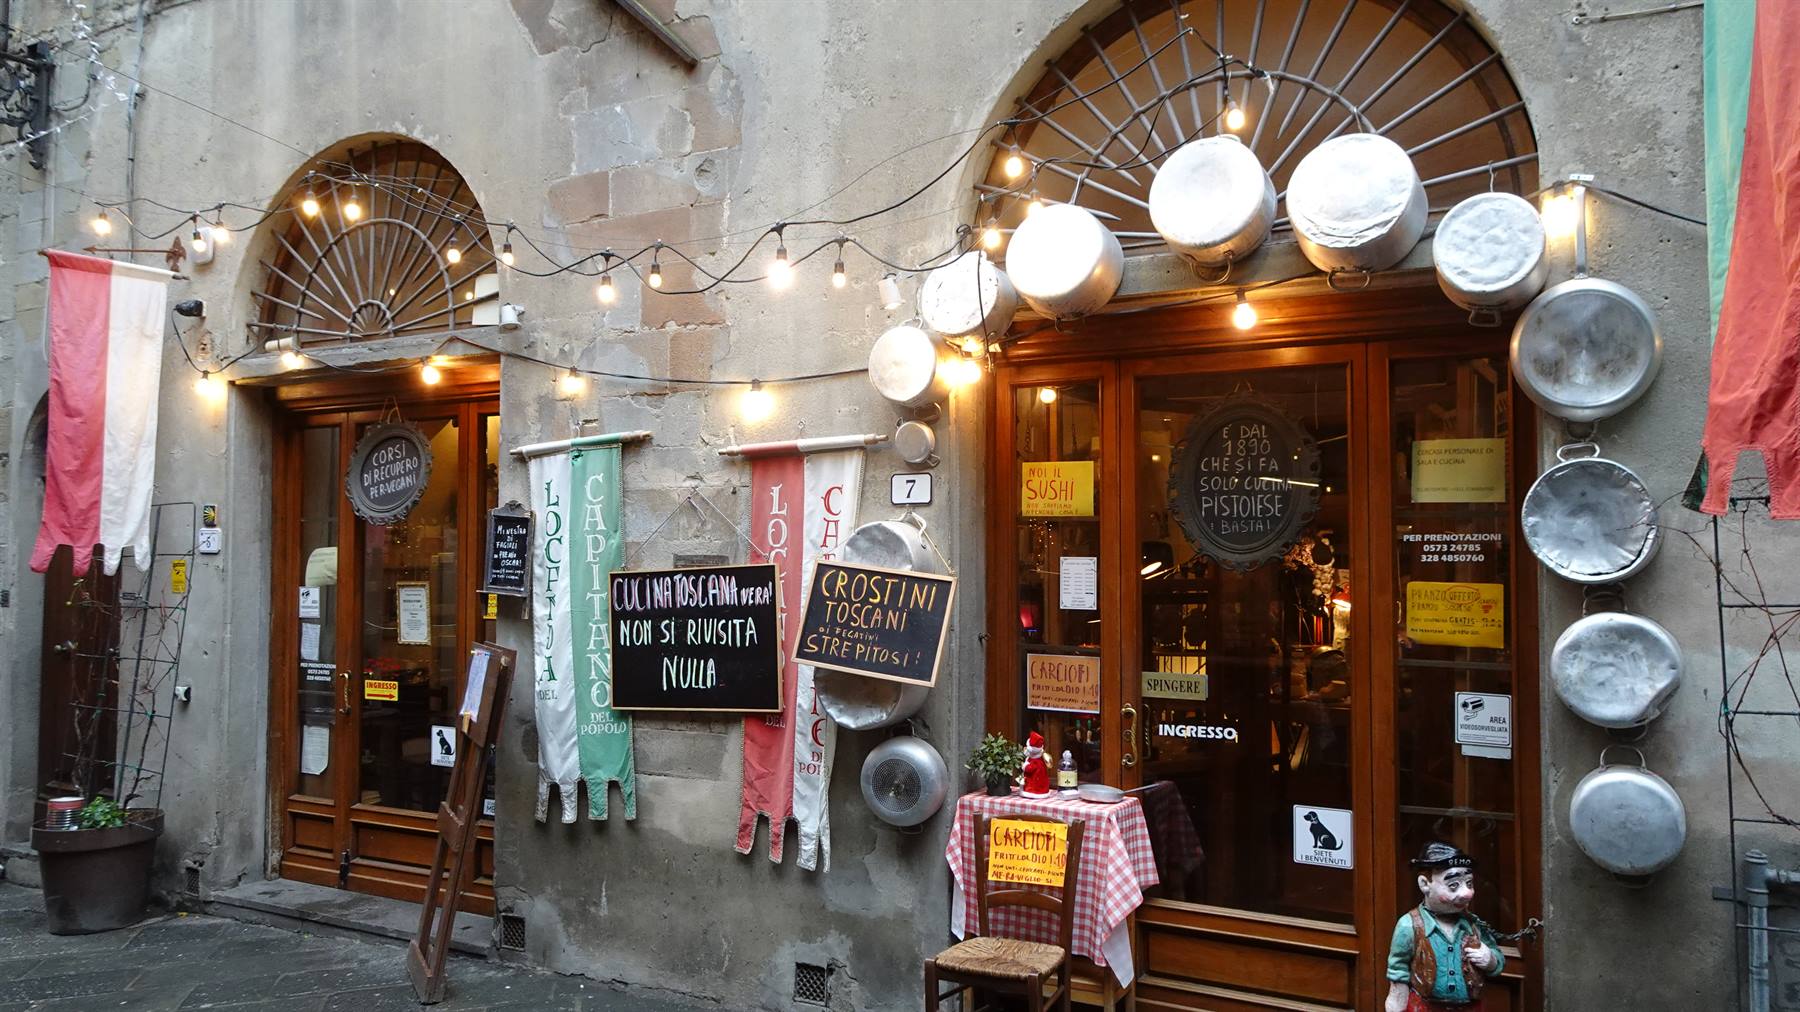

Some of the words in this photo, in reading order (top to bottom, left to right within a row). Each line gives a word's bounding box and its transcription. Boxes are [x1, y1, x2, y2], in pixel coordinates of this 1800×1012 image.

[1240, 425, 1268, 438] DAL
[372, 439, 406, 466] CORSI
[1222, 439, 1271, 456] 1890
[363, 470, 372, 486] DI
[374, 457, 418, 484] RECUPERO
[1029, 467, 1047, 478] NOI
[1201, 457, 1229, 472] CHE
[1234, 457, 1251, 472] SI
[1259, 457, 1279, 472] FA
[905, 479, 917, 499] 7
[1026, 478, 1075, 501] SUSHI
[1200, 476, 1238, 492] SOLO
[1244, 476, 1293, 492] CUCINA
[1201, 493, 1283, 517] PISTOIESE
[1221, 520, 1271, 534] BASTA!
[1423, 533, 1502, 541] PRENOTAZIONI
[1423, 544, 1448, 552] 0573
[1449, 544, 1481, 552] 24785
[1420, 554, 1439, 562] 328
[1441, 554, 1485, 562] 4850760
[612, 574, 673, 612] CUCINA
[673, 573, 738, 609] TOSCANA
[740, 580, 773, 606] VERA!
[821, 569, 937, 612] CROSTINI
[825, 600, 909, 632] TOSCANI
[620, 619, 652, 647] NON
[659, 616, 675, 645] SI
[687, 616, 758, 648] RIVISITA
[835, 625, 879, 641] FEGATINI
[662, 655, 716, 692] NULLA
[366, 681, 397, 690] INGRESSO
[1146, 678, 1200, 694] SPINGERE
[539, 689, 558, 701] DEL
[590, 711, 613, 723] DEL
[1489, 716, 1506, 724] AREA
[581, 721, 627, 735] POPOLO
[1158, 724, 1237, 740] INGRESSO
[1304, 854, 1347, 865] BENVENUTI
